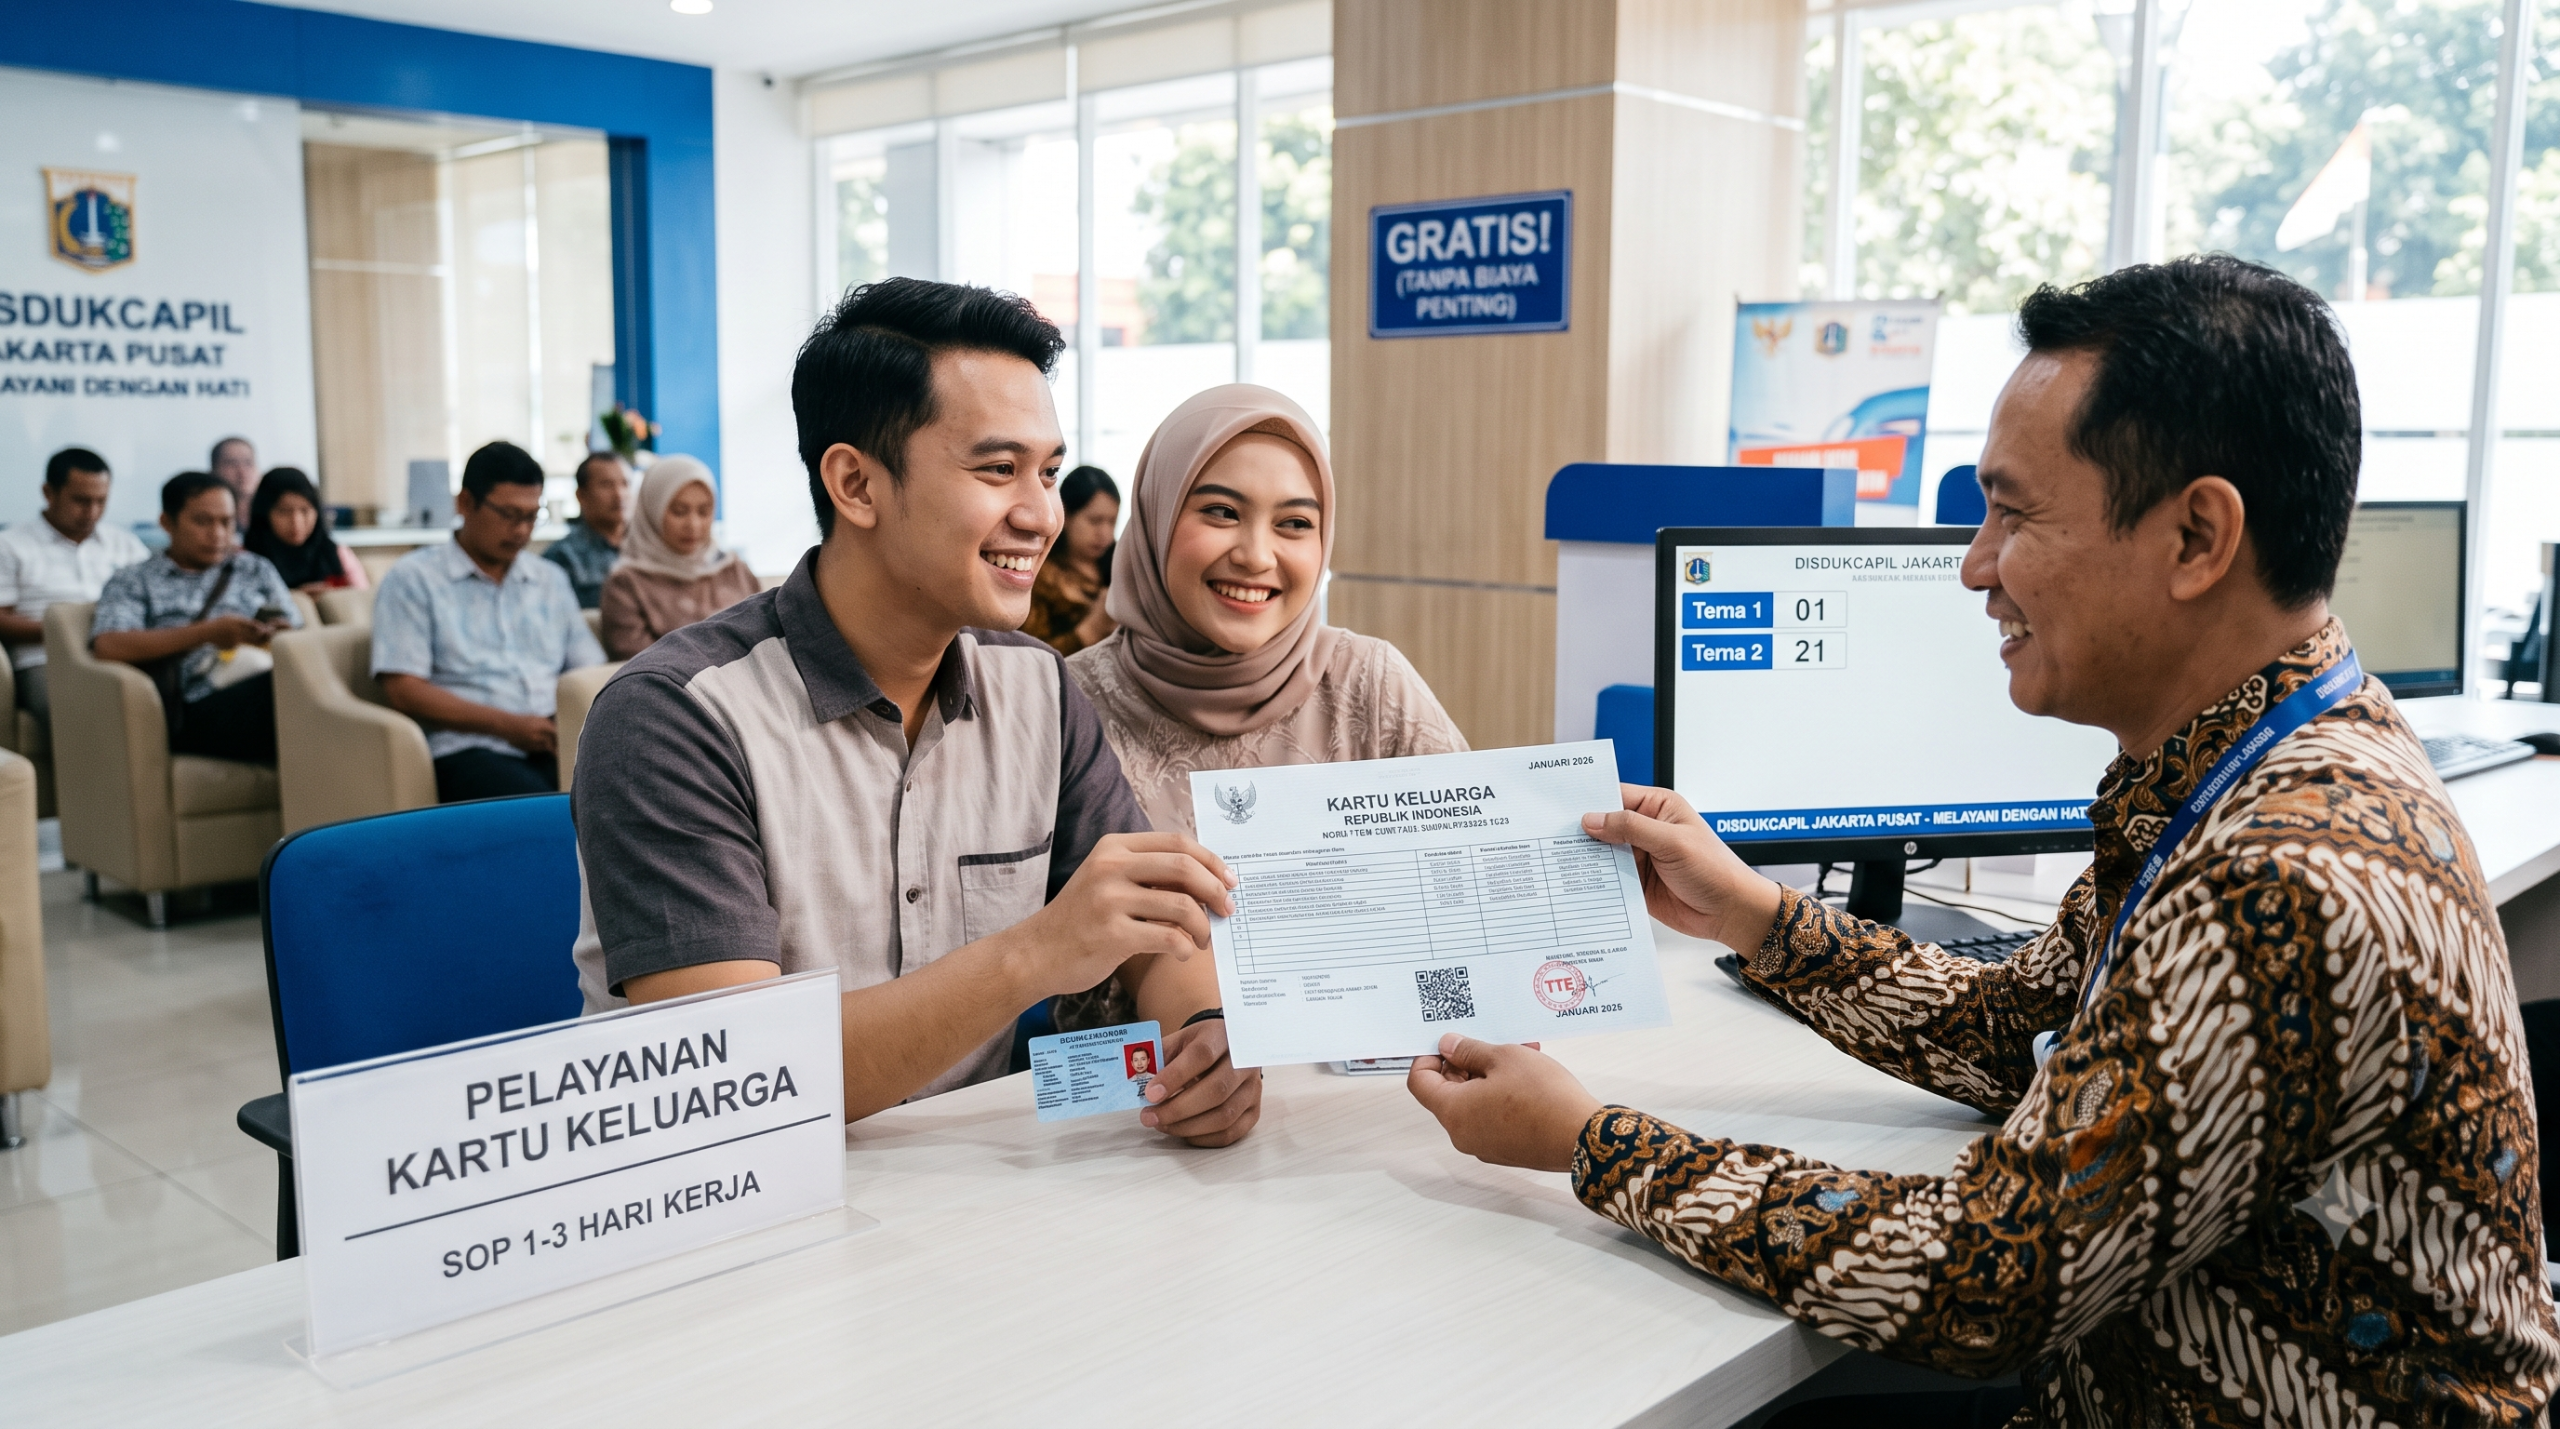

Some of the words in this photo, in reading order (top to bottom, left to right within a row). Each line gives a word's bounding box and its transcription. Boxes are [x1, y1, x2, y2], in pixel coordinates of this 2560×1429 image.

[1386, 210, 1552, 264] GRATIS!
[1396, 266, 1471, 299] (TANPA
[1473, 262, 1540, 290] BIAYA
[1415, 291, 1518, 321] PENTING)
[0, 339, 116, 366] KARTA
[126, 342, 226, 367] PUSAT
[83, 377, 190, 398] DENGAN
[197, 379, 250, 398] HATI
[1794, 556, 1898, 570] DISDUKCAPIL
[1752, 601, 1762, 619] 1
[1795, 598, 1824, 622] 01
[1751, 643, 1763, 661] 2
[1794, 639, 1823, 663] 21
[1528, 758, 1571, 771] JANUARI
[1572, 756, 1595, 767] 2026
[1326, 793, 1390, 812] KARTU
[1395, 785, 1496, 808] KELUARGA
[1343, 811, 1410, 826] REPUBLIK
[1411, 805, 1483, 821] INDONESIA
[1716, 816, 1810, 833] DISDUKCAPIL
[1811, 813, 1876, 830] JAKARTA
[1877, 812, 1922, 827] PUSAT
[1933, 809, 2000, 826] MELAYANI
[2001, 807, 2059, 823] DENGAN
[2060, 806, 2088, 820] HAT
[1544, 977, 1575, 994] TTE
[1555, 1005, 1599, 1018] JANUARI
[465, 1028, 730, 1121] PELAYANAN
[386, 1120, 550, 1195] KARTU
[566, 1065, 799, 1152] KELUARGA
[442, 1236, 512, 1280] SOP
[523, 1221, 568, 1257] 1-3
[579, 1198, 654, 1243] HARI
[664, 1169, 762, 1220] KERJA
